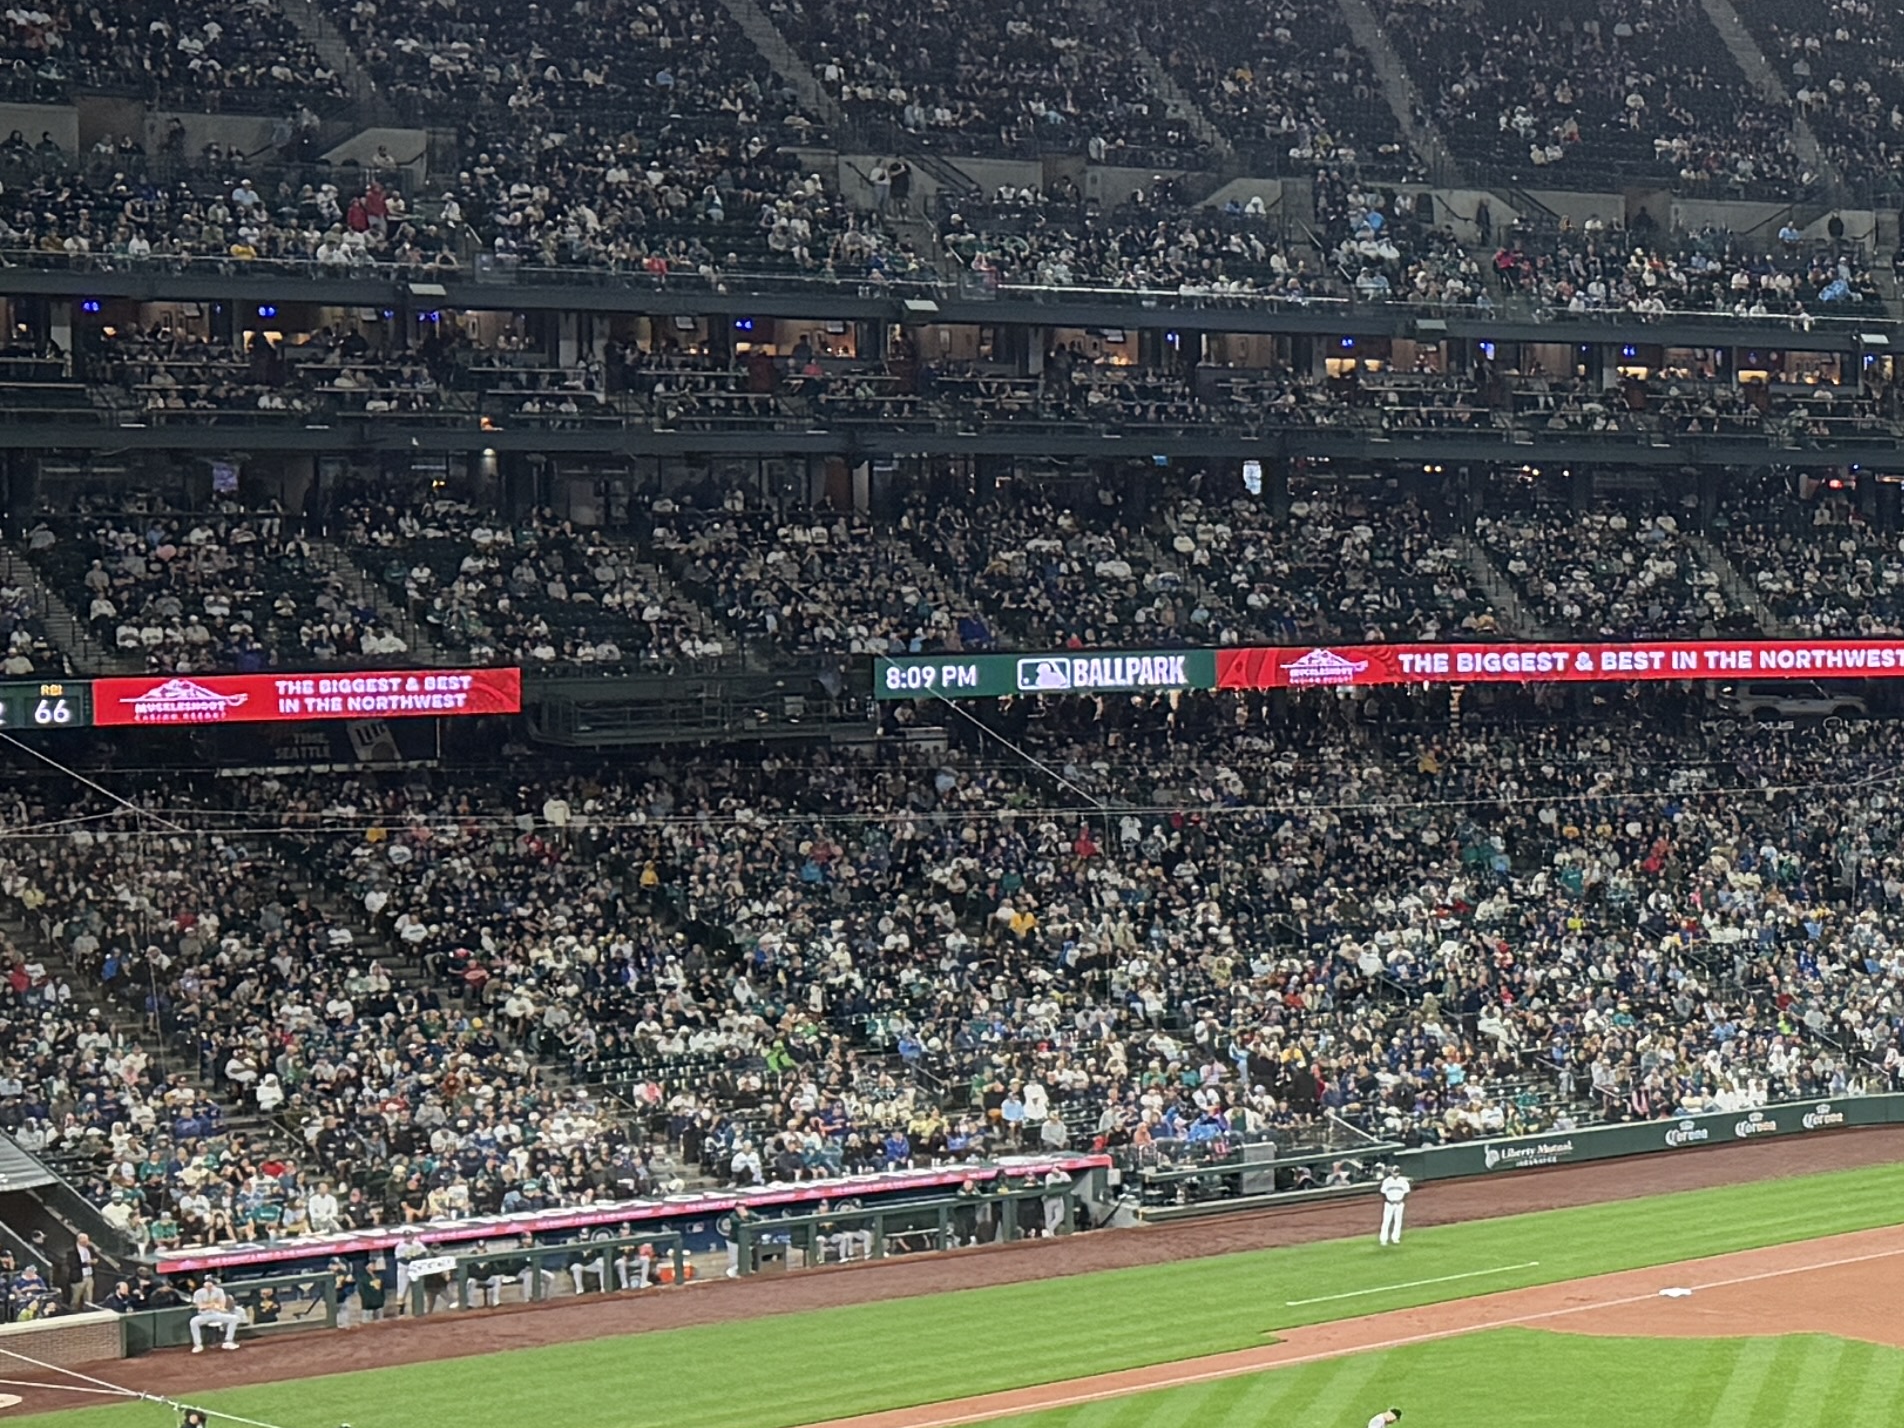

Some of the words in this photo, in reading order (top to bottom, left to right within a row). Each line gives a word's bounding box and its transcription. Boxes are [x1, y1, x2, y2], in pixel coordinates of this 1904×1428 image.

[1074, 655, 1186, 687] BALLPARK
[1399, 653, 1450, 673] THE
[1457, 652, 1569, 673] BIGGEST
[1575, 651, 1593, 671] &
[1600, 650, 1662, 671] BEST
[1671, 649, 1698, 670] IN
[1705, 649, 1752, 669] THE
[275, 680, 314, 695] THE
[319, 678, 402, 694] BIGGEST
[406, 677, 420, 692] &
[425, 676, 472, 691] BEST
[885, 665, 937, 690] 8:09
[942, 665, 977, 687] PM
[34, 699, 71, 724] 66
[279, 698, 301, 713] IN
[306, 696, 343, 713] THE
[347, 693, 468, 712] NORTHWEST
[1735, 1120, 1777, 1138] Corona
[1802, 1112, 1844, 1130] Corona
[1665, 1129, 1708, 1147] Corona
[1501, 1147, 1536, 1163] Liberty
[1537, 1140, 1574, 1154] Mutual
